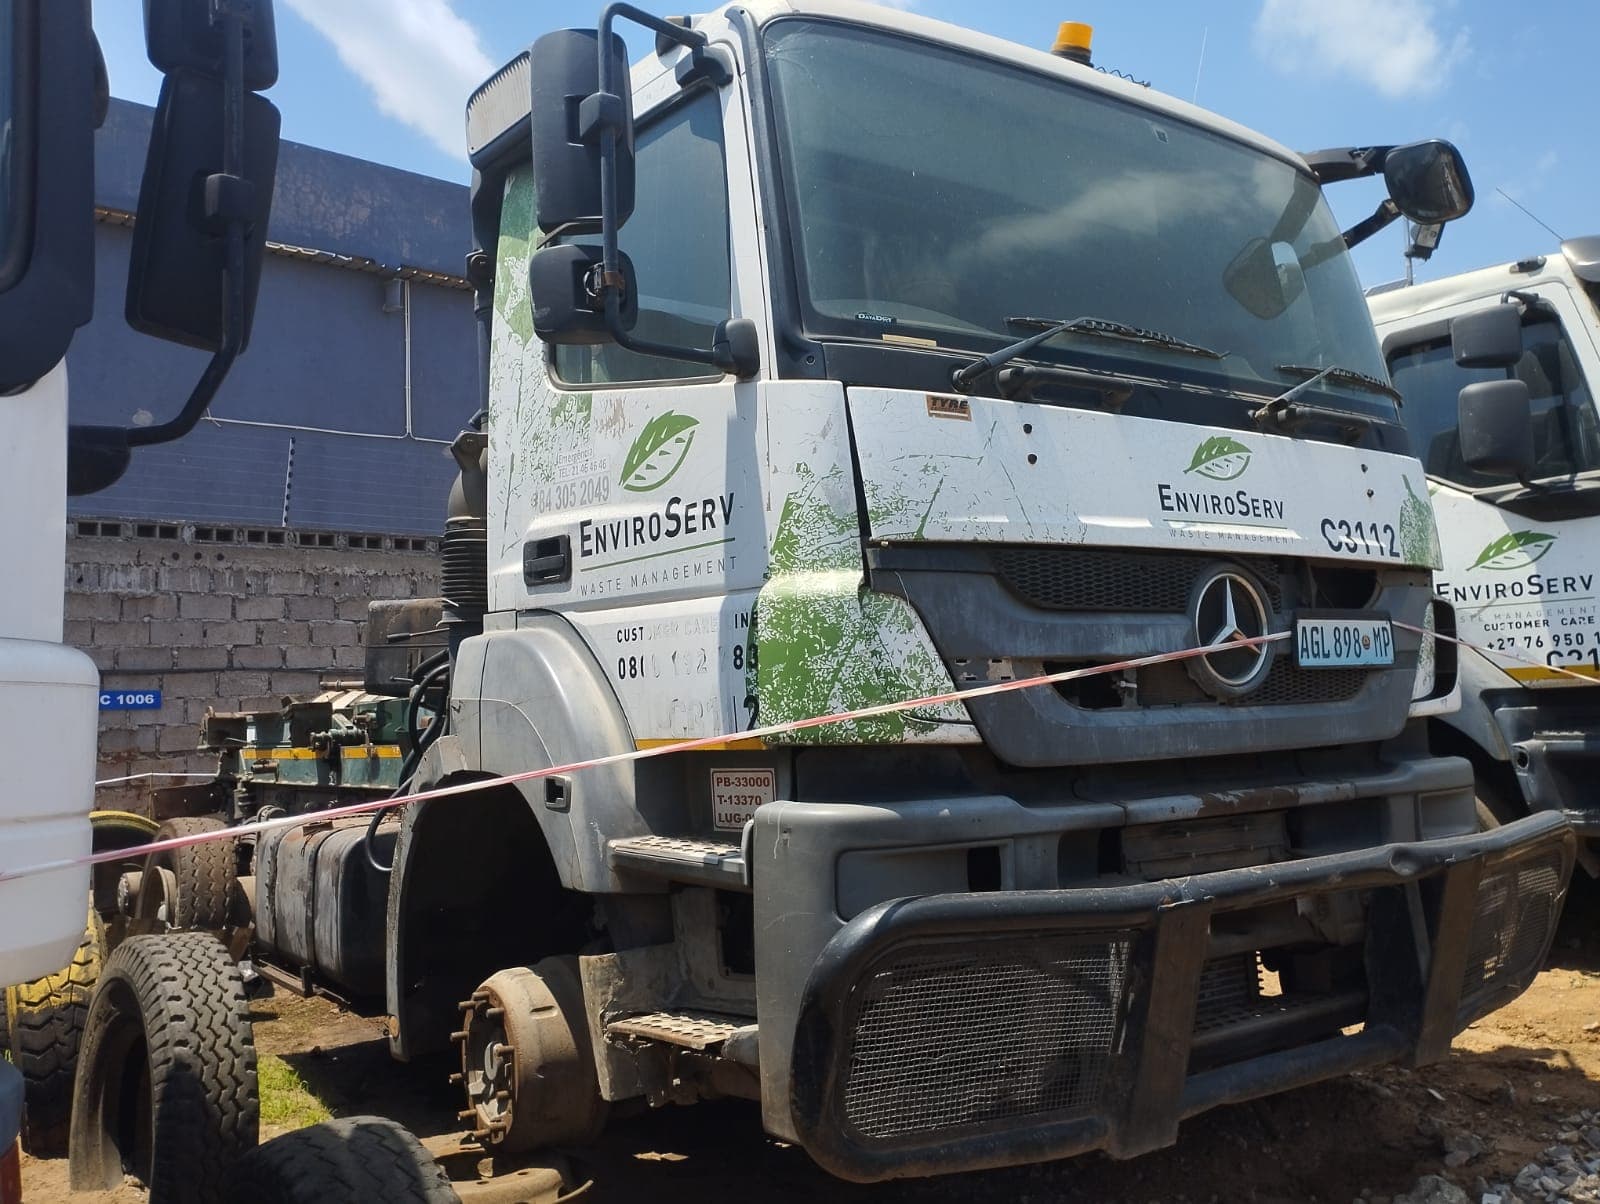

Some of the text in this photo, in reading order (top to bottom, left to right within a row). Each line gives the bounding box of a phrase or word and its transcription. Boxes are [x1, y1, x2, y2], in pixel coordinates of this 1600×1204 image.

[555, 483, 576, 510] 305
[580, 475, 609, 505] 2049
[1157, 483, 1284, 520] ENVIROSERV
[579, 492, 735, 558] ENVIROSERV
[1169, 529, 1296, 545] WASTE MANAGEMENT
[1320, 518, 1401, 558] C3112
[580, 555, 738, 597] WASTE MANAGEMENT
[1300, 625, 1390, 660] AGL 898 MP
[1524, 635, 1544, 649] 76
[1552, 632, 1584, 647] 950
[115, 693, 154, 705] 1006
[715, 776, 770, 788] PB-33000
[716, 794, 762, 806] T-13370
[717, 812, 753, 824] LUG-0
